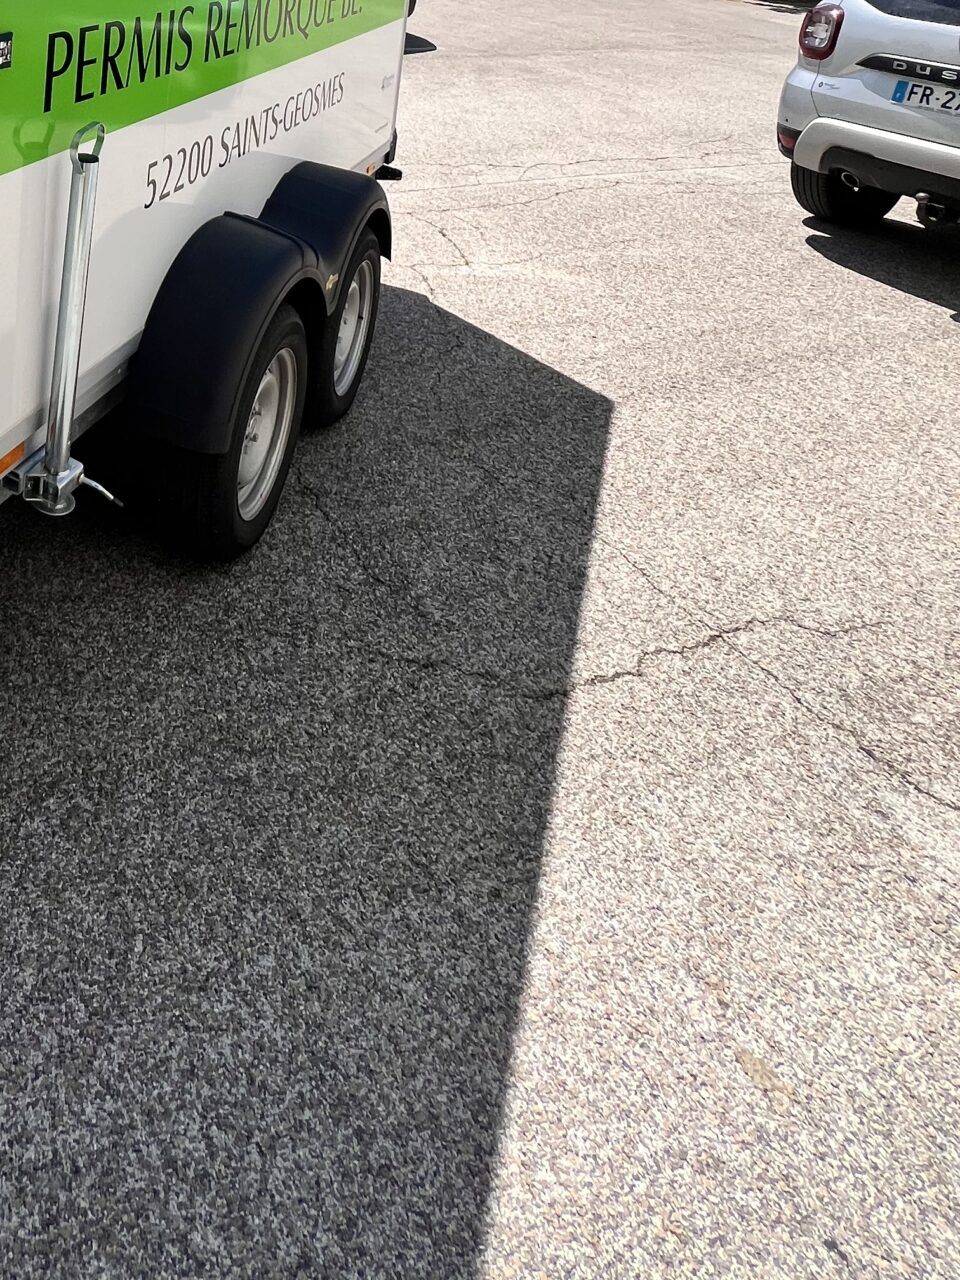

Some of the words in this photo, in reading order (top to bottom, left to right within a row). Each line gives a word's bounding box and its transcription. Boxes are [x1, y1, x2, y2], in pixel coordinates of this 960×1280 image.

[42, 4, 195, 114] PERMIS
[143, 134, 214, 210] 52200
[218, 71, 346, 169] SAINTS-GEOSMES
